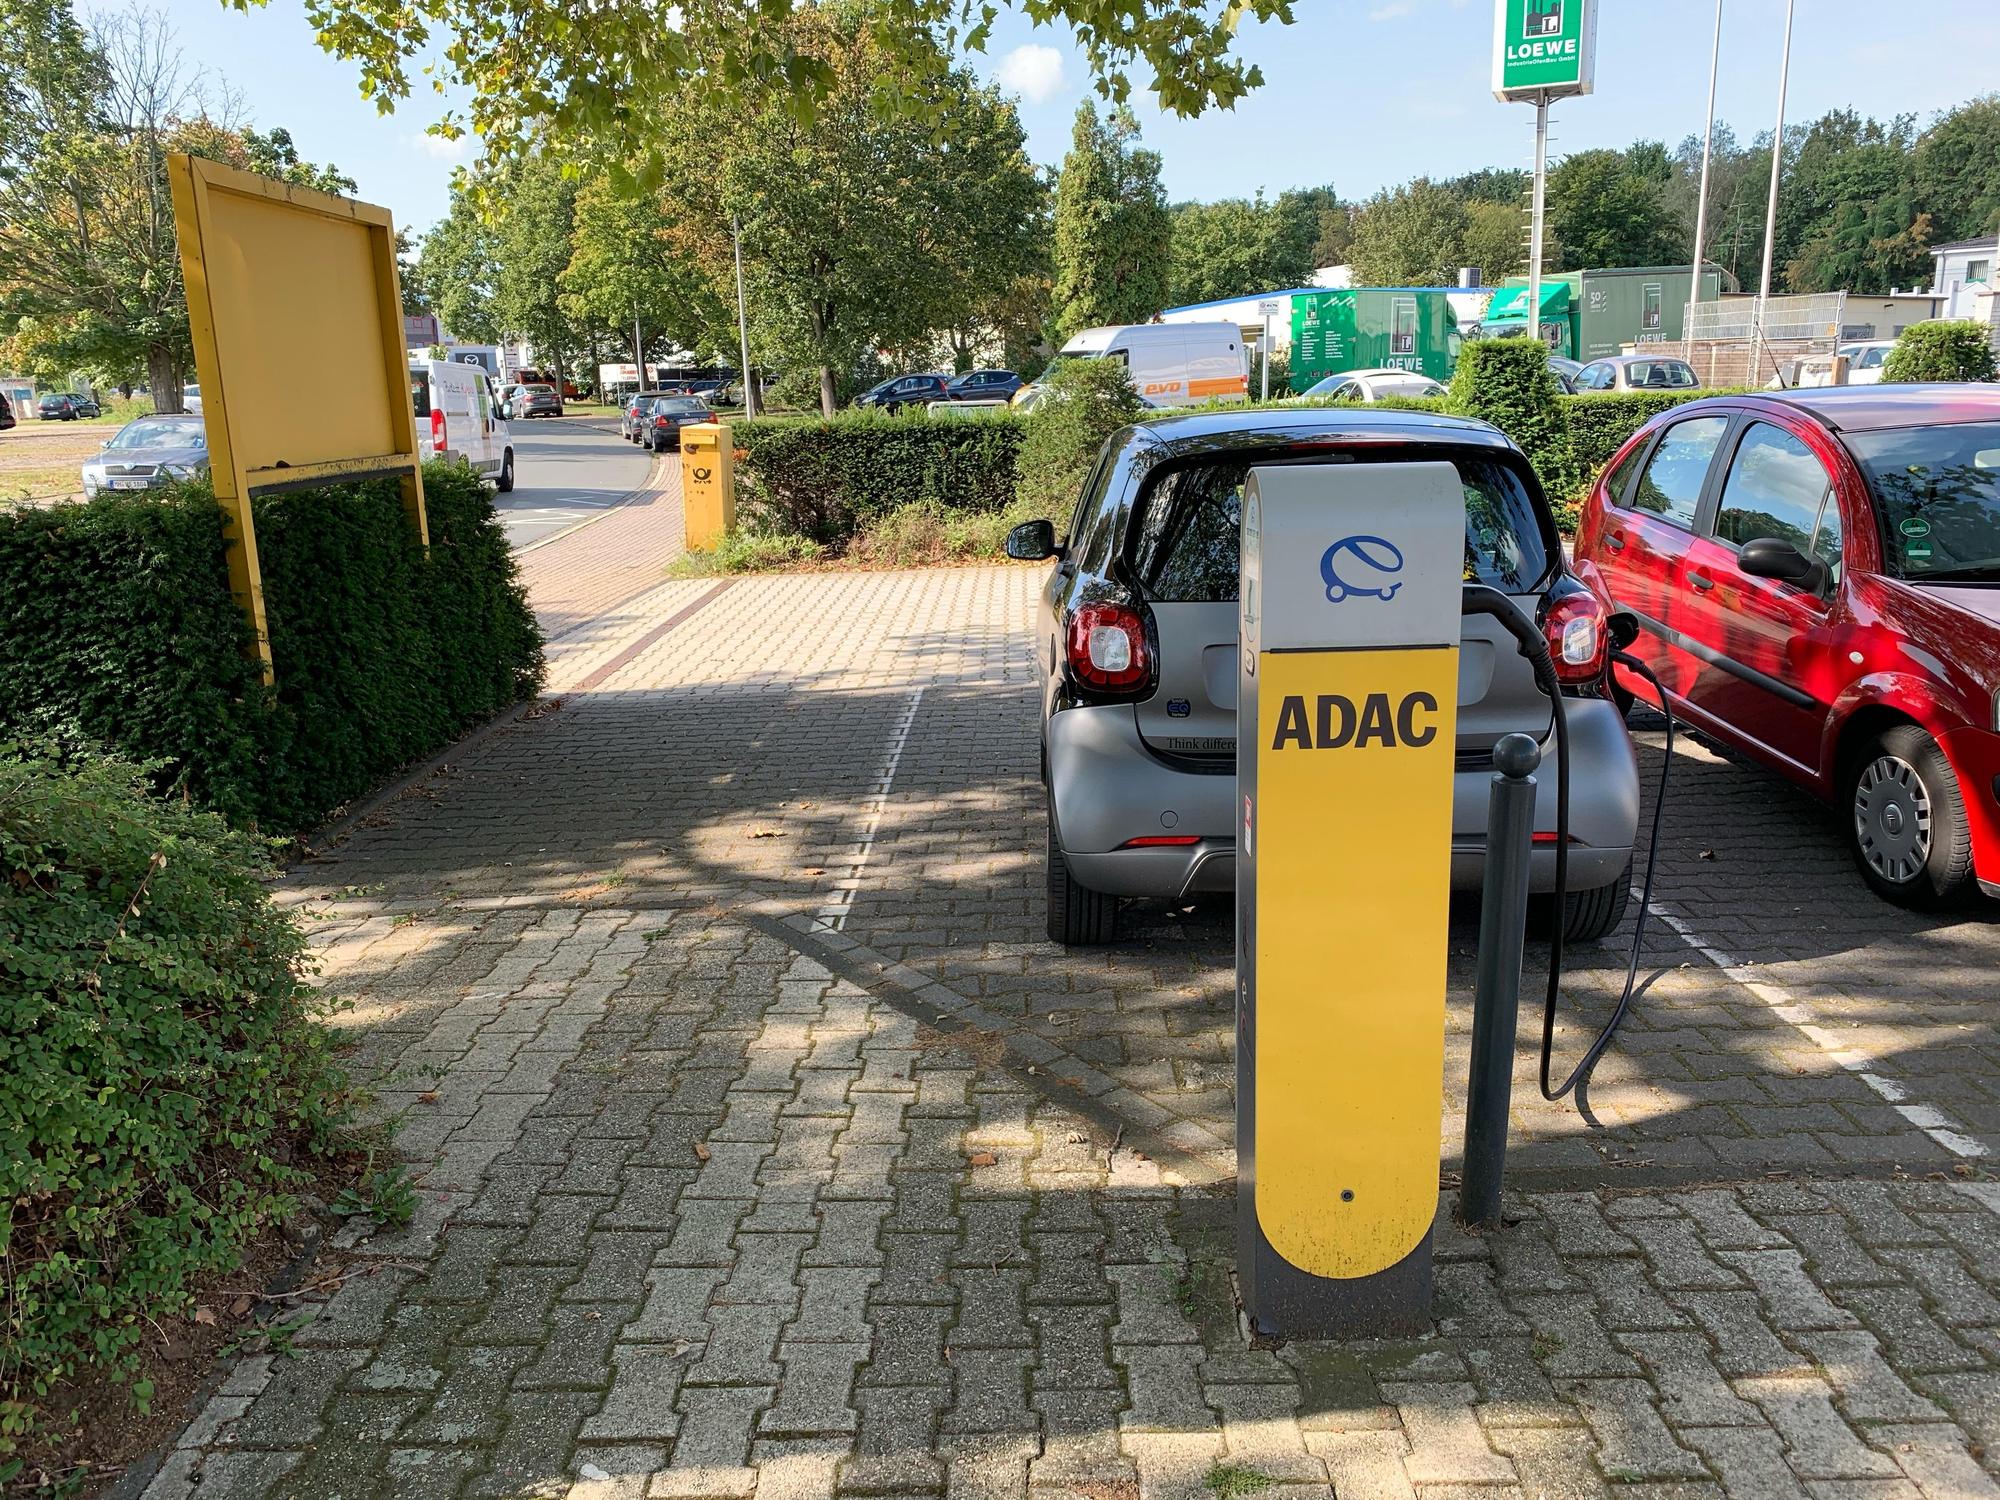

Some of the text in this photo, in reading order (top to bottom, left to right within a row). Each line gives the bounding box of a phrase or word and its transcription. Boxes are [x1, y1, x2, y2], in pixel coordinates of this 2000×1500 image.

[1507, 39, 1576, 60] LOEWE
[1590, 291, 1601, 304] 50
[1634, 332, 1667, 343] LOEWE
[1380, 357, 1423, 370] LOEWE
[1144, 382, 1181, 395] evo
[1272, 691, 1438, 750] ADAC
[1168, 737, 1200, 749] Think
